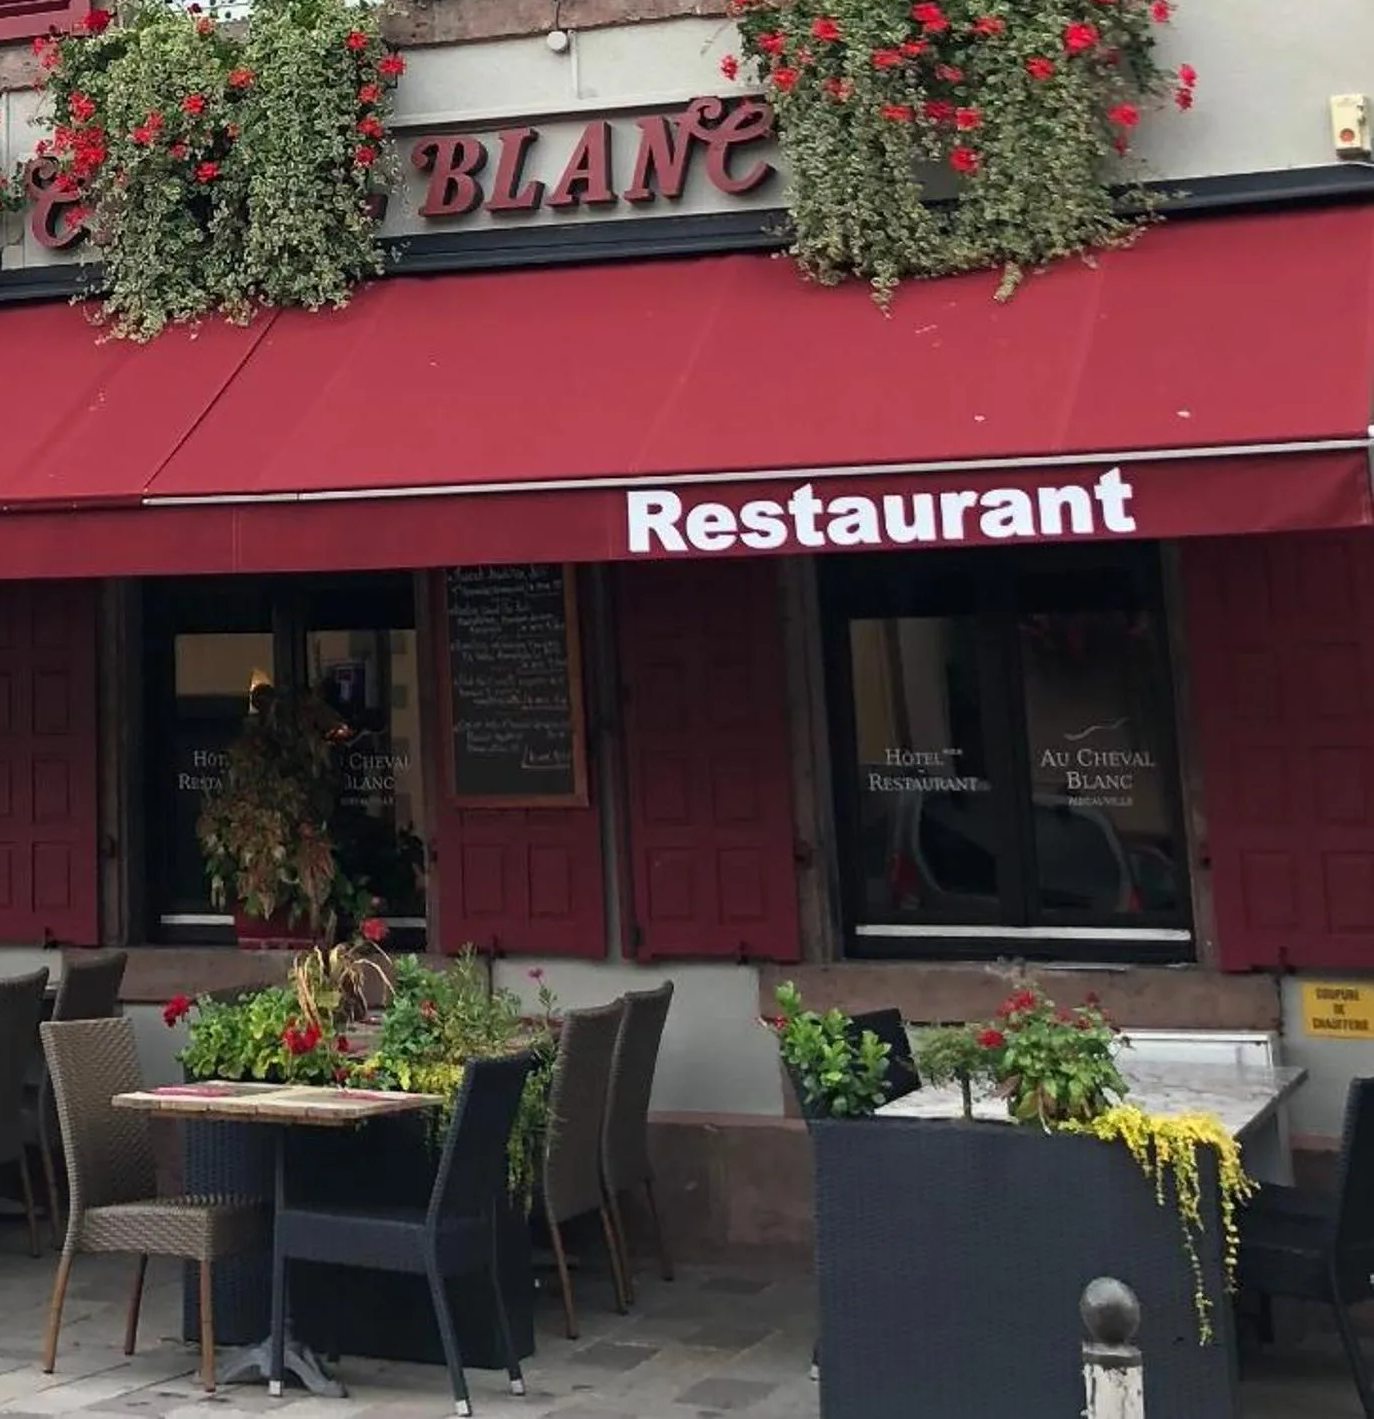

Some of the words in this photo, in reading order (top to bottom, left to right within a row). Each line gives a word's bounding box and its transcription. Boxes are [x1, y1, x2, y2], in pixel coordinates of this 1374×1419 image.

[411, 96, 777, 219] BLANC
[626, 467, 1137, 553] Restaurant
[1040, 748, 1069, 768] AU
[1077, 748, 1156, 768] CHEVAL
[868, 773, 978, 791] RESTAURANT
[1066, 771, 1133, 790] BLANC
